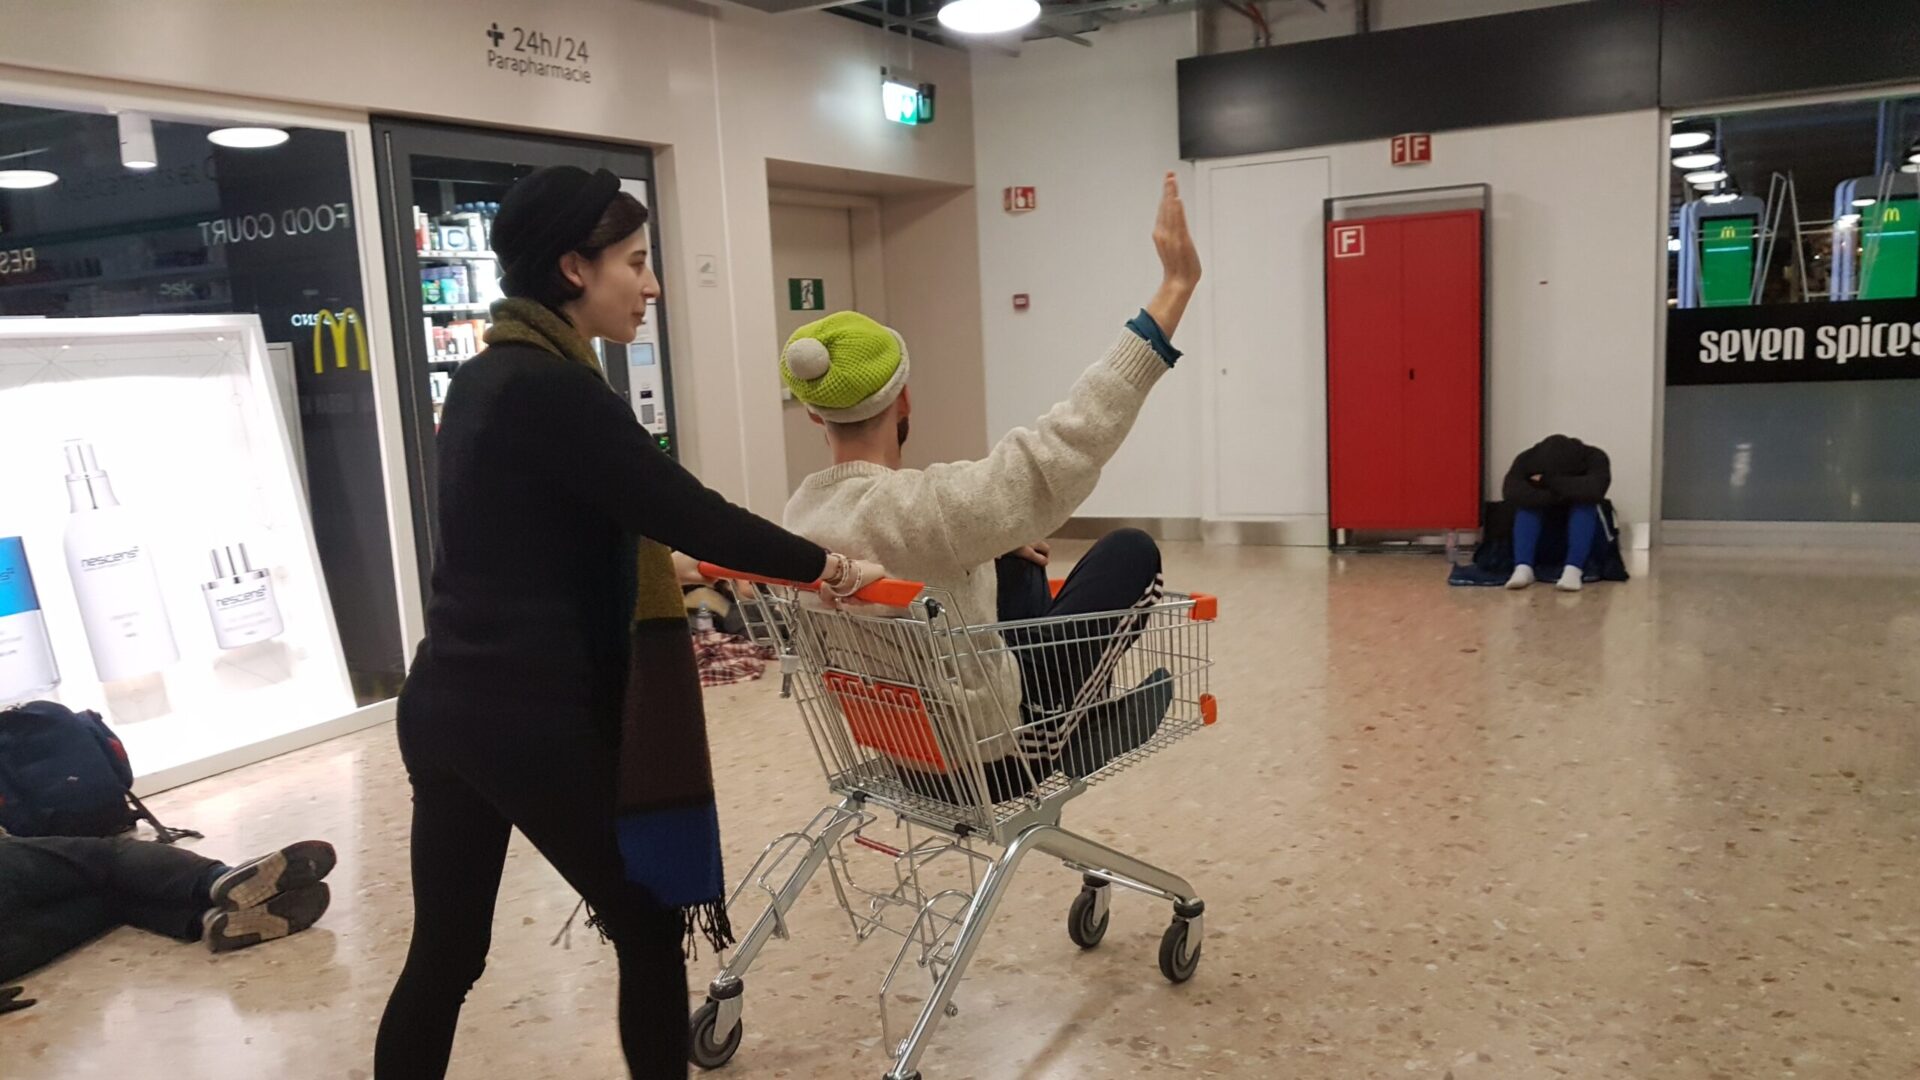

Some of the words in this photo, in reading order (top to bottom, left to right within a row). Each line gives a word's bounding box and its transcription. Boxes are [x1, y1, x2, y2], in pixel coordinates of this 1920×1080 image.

[513, 27, 589, 64] 24h/24
[487, 49, 591, 84] Parapharmacie
[1394, 140, 1403, 161] F
[1413, 137, 1427, 159] F
[1341, 230, 1357, 253] F
[1699, 326, 1805, 363] seven
